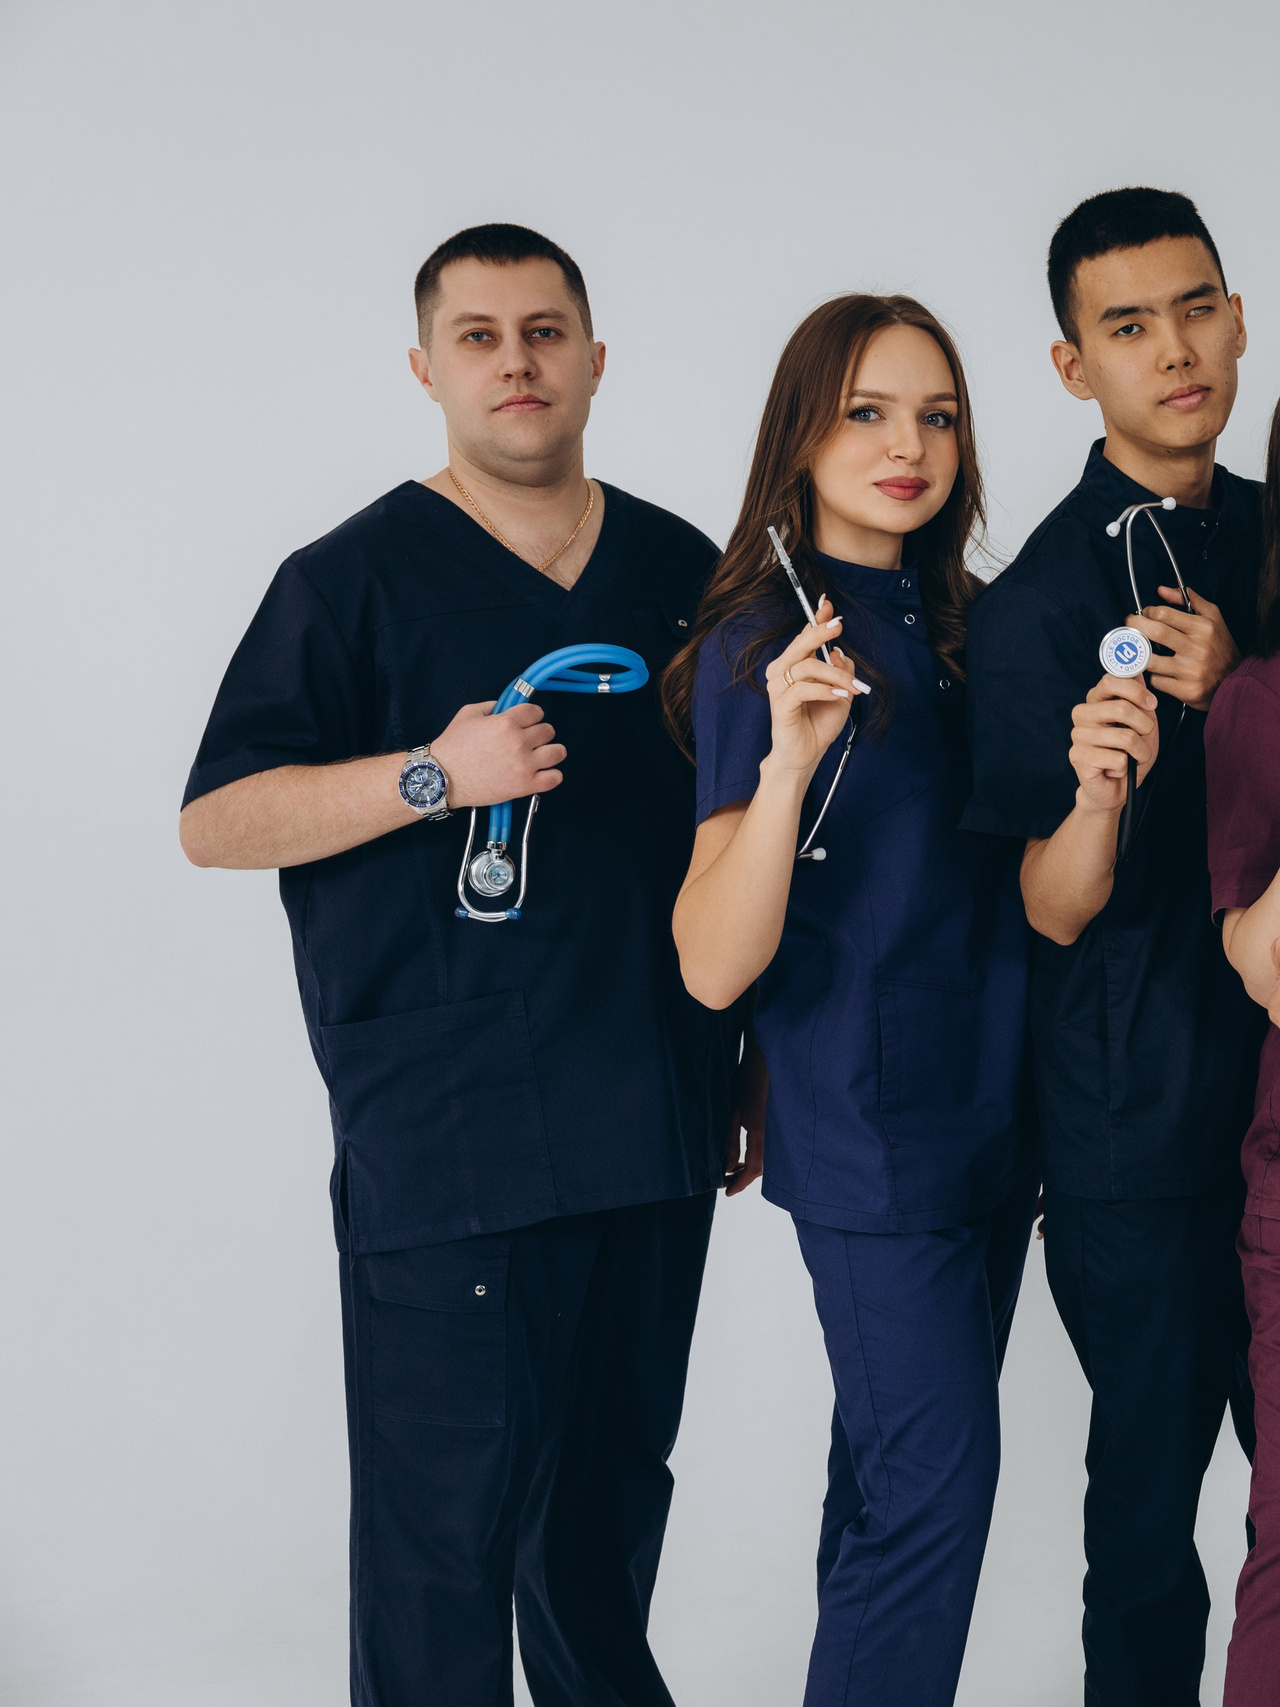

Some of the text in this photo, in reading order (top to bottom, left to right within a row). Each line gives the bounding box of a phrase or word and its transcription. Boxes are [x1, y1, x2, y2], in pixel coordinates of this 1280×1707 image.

[1109, 635, 1139, 667] LITTLE DOCTOR
[1125, 651, 1144, 671] QUALITY
